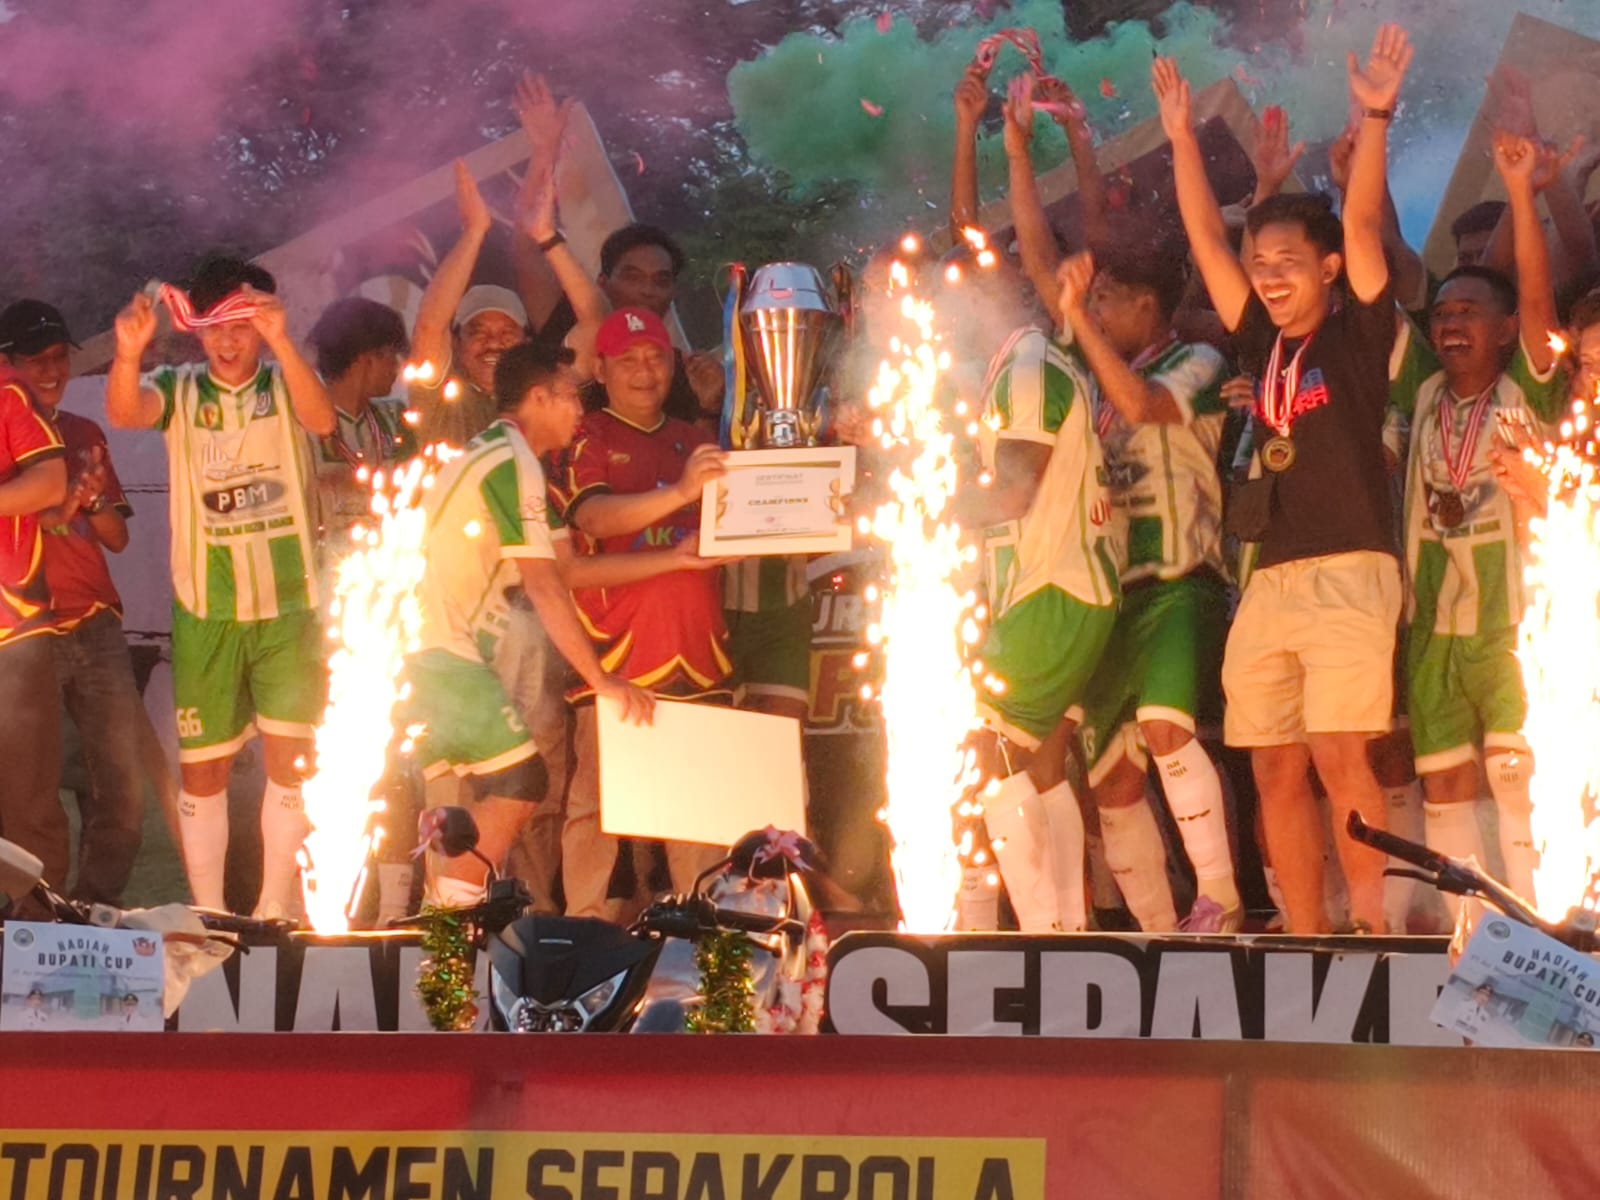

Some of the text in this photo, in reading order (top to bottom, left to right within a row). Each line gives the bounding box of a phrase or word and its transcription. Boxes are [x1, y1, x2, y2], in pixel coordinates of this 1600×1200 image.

[217, 484, 269, 512] PBM
[176, 706, 204, 738] 66
[38, 952, 133, 969] BUPATI CUP
[1502, 950, 1568, 990] BUPATI
[1, 1143, 1015, 1200] TOURNAMEN SEPAKBOLA
